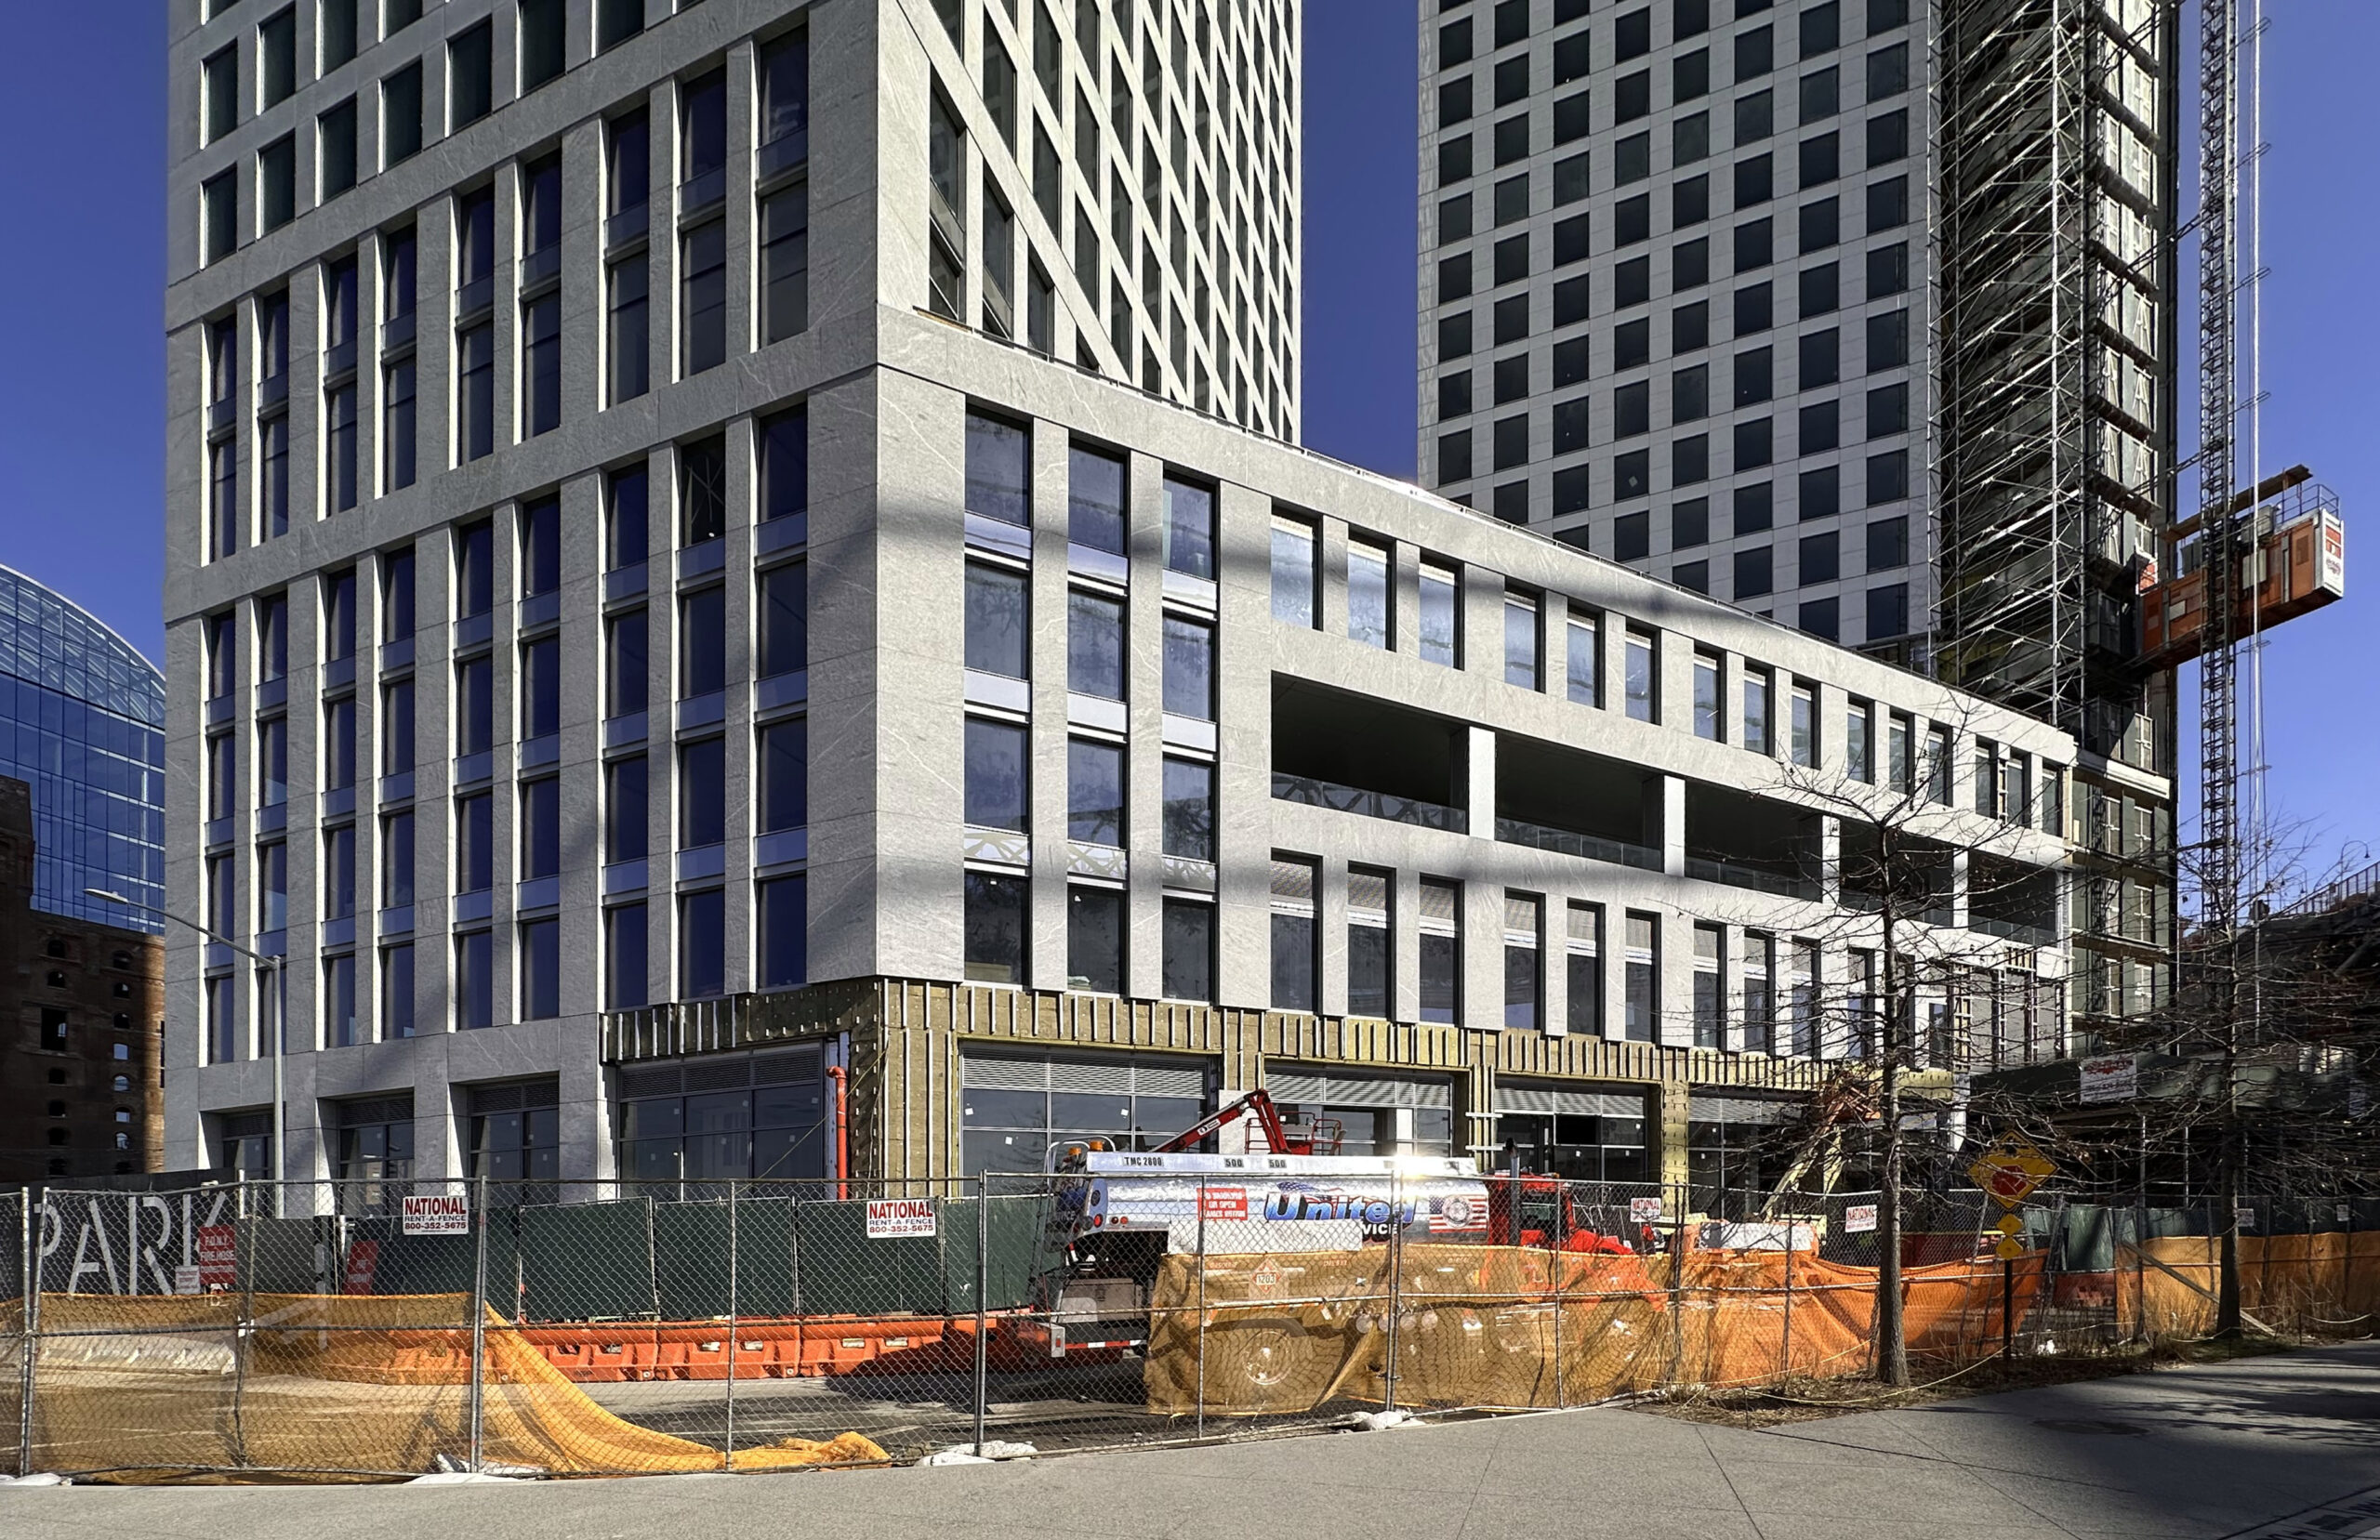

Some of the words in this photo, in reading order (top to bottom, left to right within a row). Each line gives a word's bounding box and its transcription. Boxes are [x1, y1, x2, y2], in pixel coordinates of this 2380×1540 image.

[1124, 1157, 1142, 1165] TMC
[1225, 1159, 1243, 1167] 500
[1269, 1160, 1286, 1168] 500
[405, 1197, 467, 1215] NATIONAL
[1264, 1192, 1418, 1224] United
[1633, 1199, 1659, 1209] NATIONAL
[869, 1201, 933, 1218] NATIONAL
[1847, 1207, 1874, 1220] NATIONAL
[869, 1218, 934, 1226] RENT-A-FENCE
[33, 1191, 226, 1296] PARK
[200, 1251, 215, 1261] FIRE
[1257, 1274, 1276, 1283] 1203
